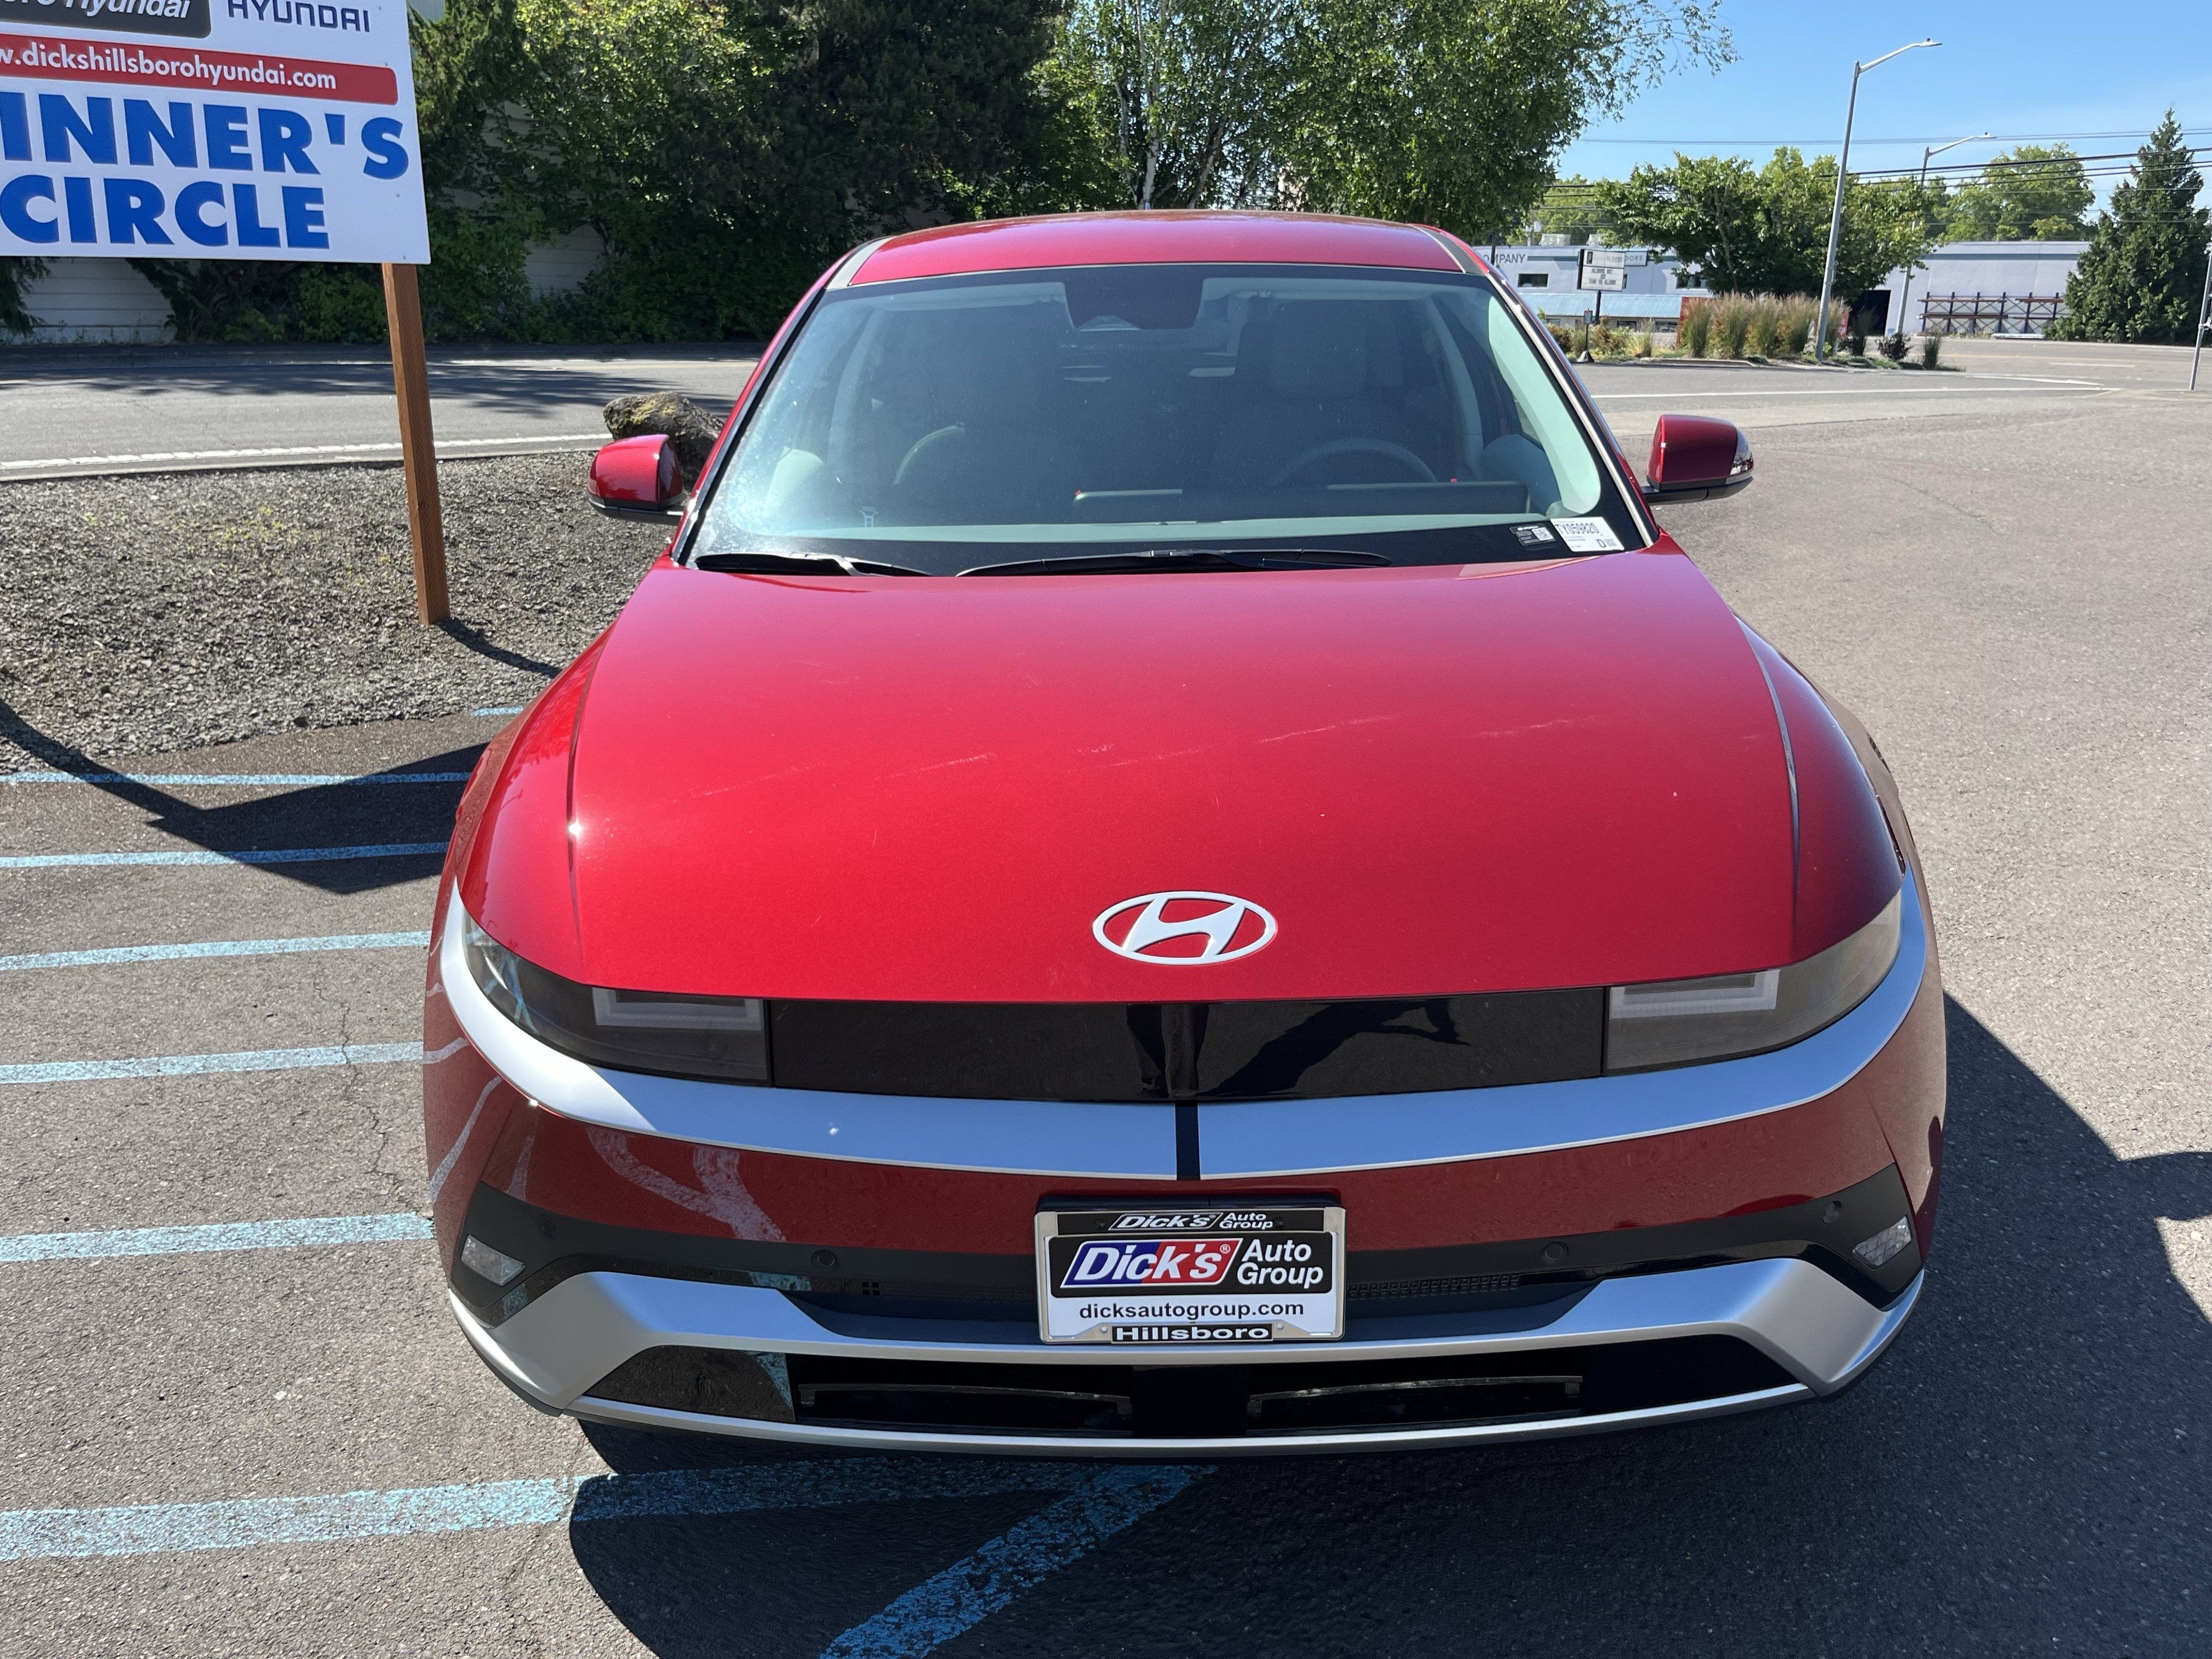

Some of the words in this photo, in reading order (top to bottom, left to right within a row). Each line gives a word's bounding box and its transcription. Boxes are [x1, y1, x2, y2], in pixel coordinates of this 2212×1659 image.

[228, 0, 370, 33] HYUNDAI
[0, 92, 409, 179] INNER'S
[0, 175, 329, 249] CIRCLE
[1116, 1213, 1210, 1228] Dick's
[1223, 1212, 1267, 1221] Auto
[1219, 1220, 1273, 1229] Group
[1073, 1243, 1221, 1280] Dick's
[1242, 1239, 1312, 1262] Auto
[1237, 1263, 1323, 1289] Group
[1079, 1302, 1304, 1320] dicksautogroup.com
[1116, 1327, 1269, 1340] Hillsboro
